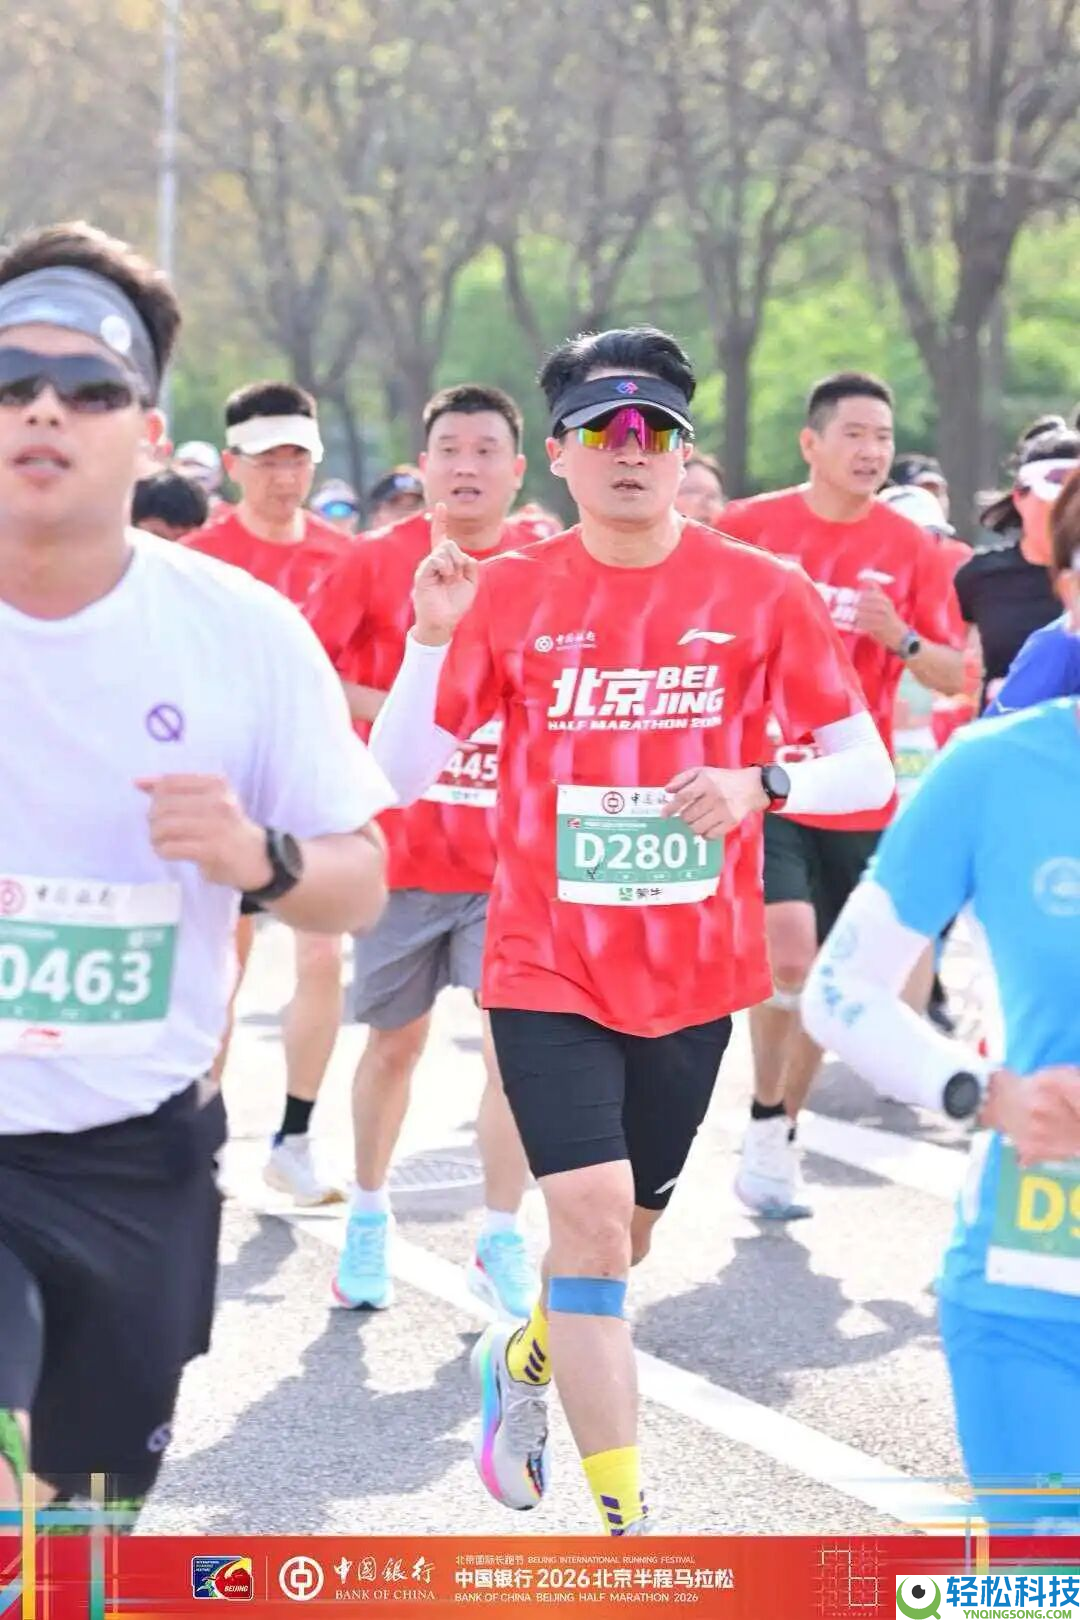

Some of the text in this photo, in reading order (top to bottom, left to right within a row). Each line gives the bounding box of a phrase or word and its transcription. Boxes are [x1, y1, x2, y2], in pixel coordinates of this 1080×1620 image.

[656, 666, 720, 689] BEI
[547, 668, 657, 717] 北京
[651, 688, 725, 715] JING
[548, 720, 588, 731] HALF
[590, 718, 689, 731] MARATHON
[574, 832, 708, 870] D2801
